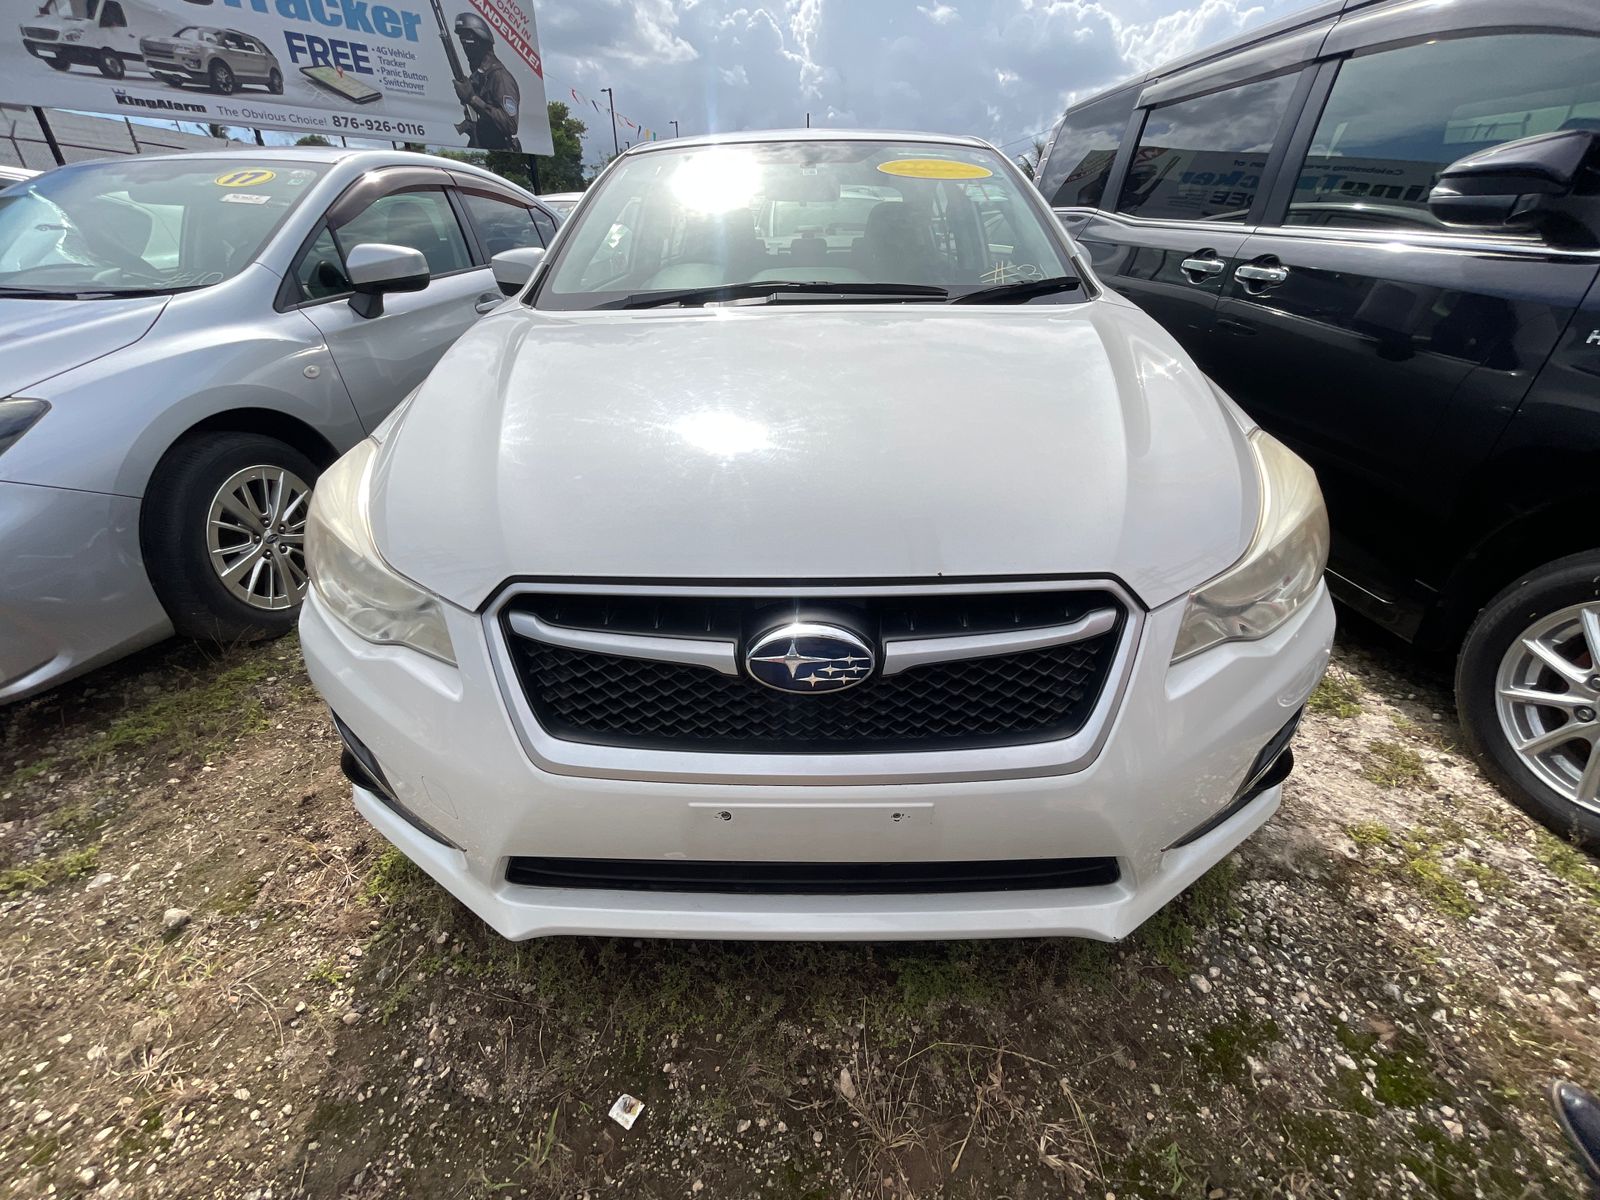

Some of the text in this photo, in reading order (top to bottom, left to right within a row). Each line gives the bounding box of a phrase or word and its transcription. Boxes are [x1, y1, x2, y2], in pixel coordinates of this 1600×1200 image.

[223, 0, 421, 42] acker
[496, 1, 532, 41] OPEN IN
[507, 0, 530, 24] NOW
[473, 0, 540, 69] ANDEVILLE!
[283, 30, 374, 75] FREE
[376, 46, 416, 61] 4G Vehicle
[377, 55, 406, 68] Tracker
[380, 66, 429, 81] Panic Button
[383, 77, 424, 90] Switchover
[115, 94, 425, 136] KingAlarm The Obvious Choice! 876-926-0116
